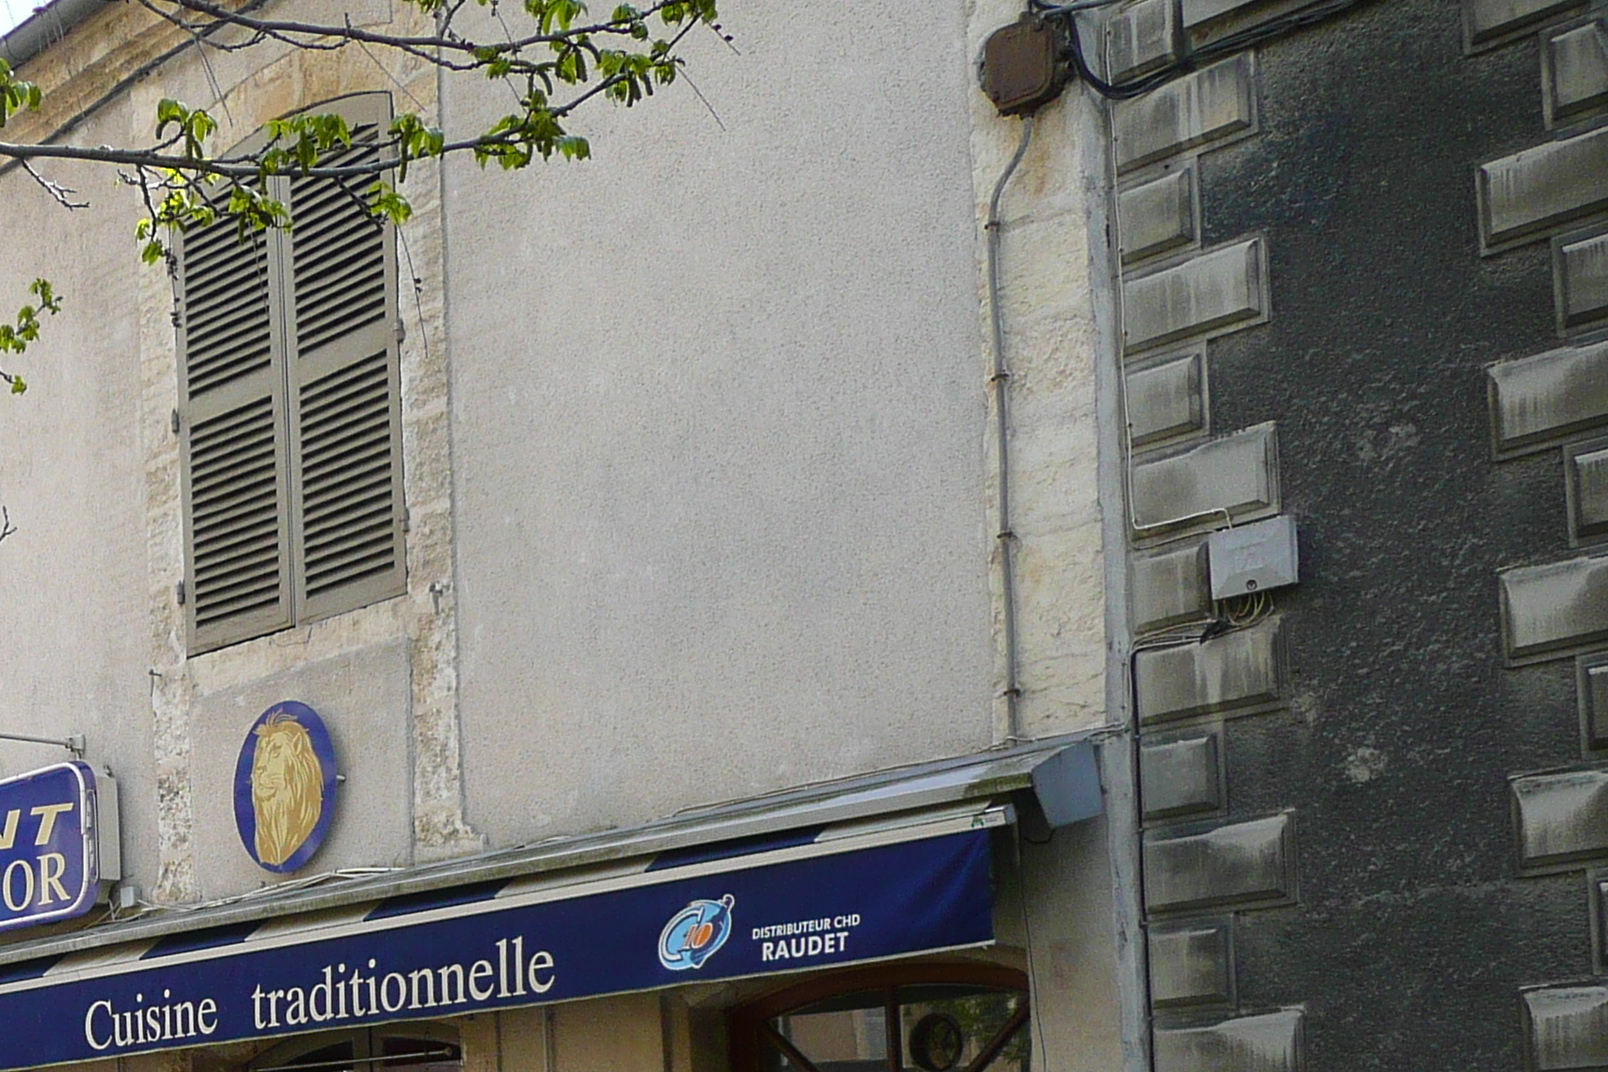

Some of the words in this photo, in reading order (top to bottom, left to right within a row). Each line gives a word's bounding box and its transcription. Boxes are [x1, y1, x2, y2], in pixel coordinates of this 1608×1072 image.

[752, 918, 831, 940] DISTRIBUTEUR
[833, 914, 861, 928] CHD
[761, 932, 849, 962] RAUDET
[84, 989, 219, 1052] Cuisine
[250, 934, 556, 1029] traditionnelle
